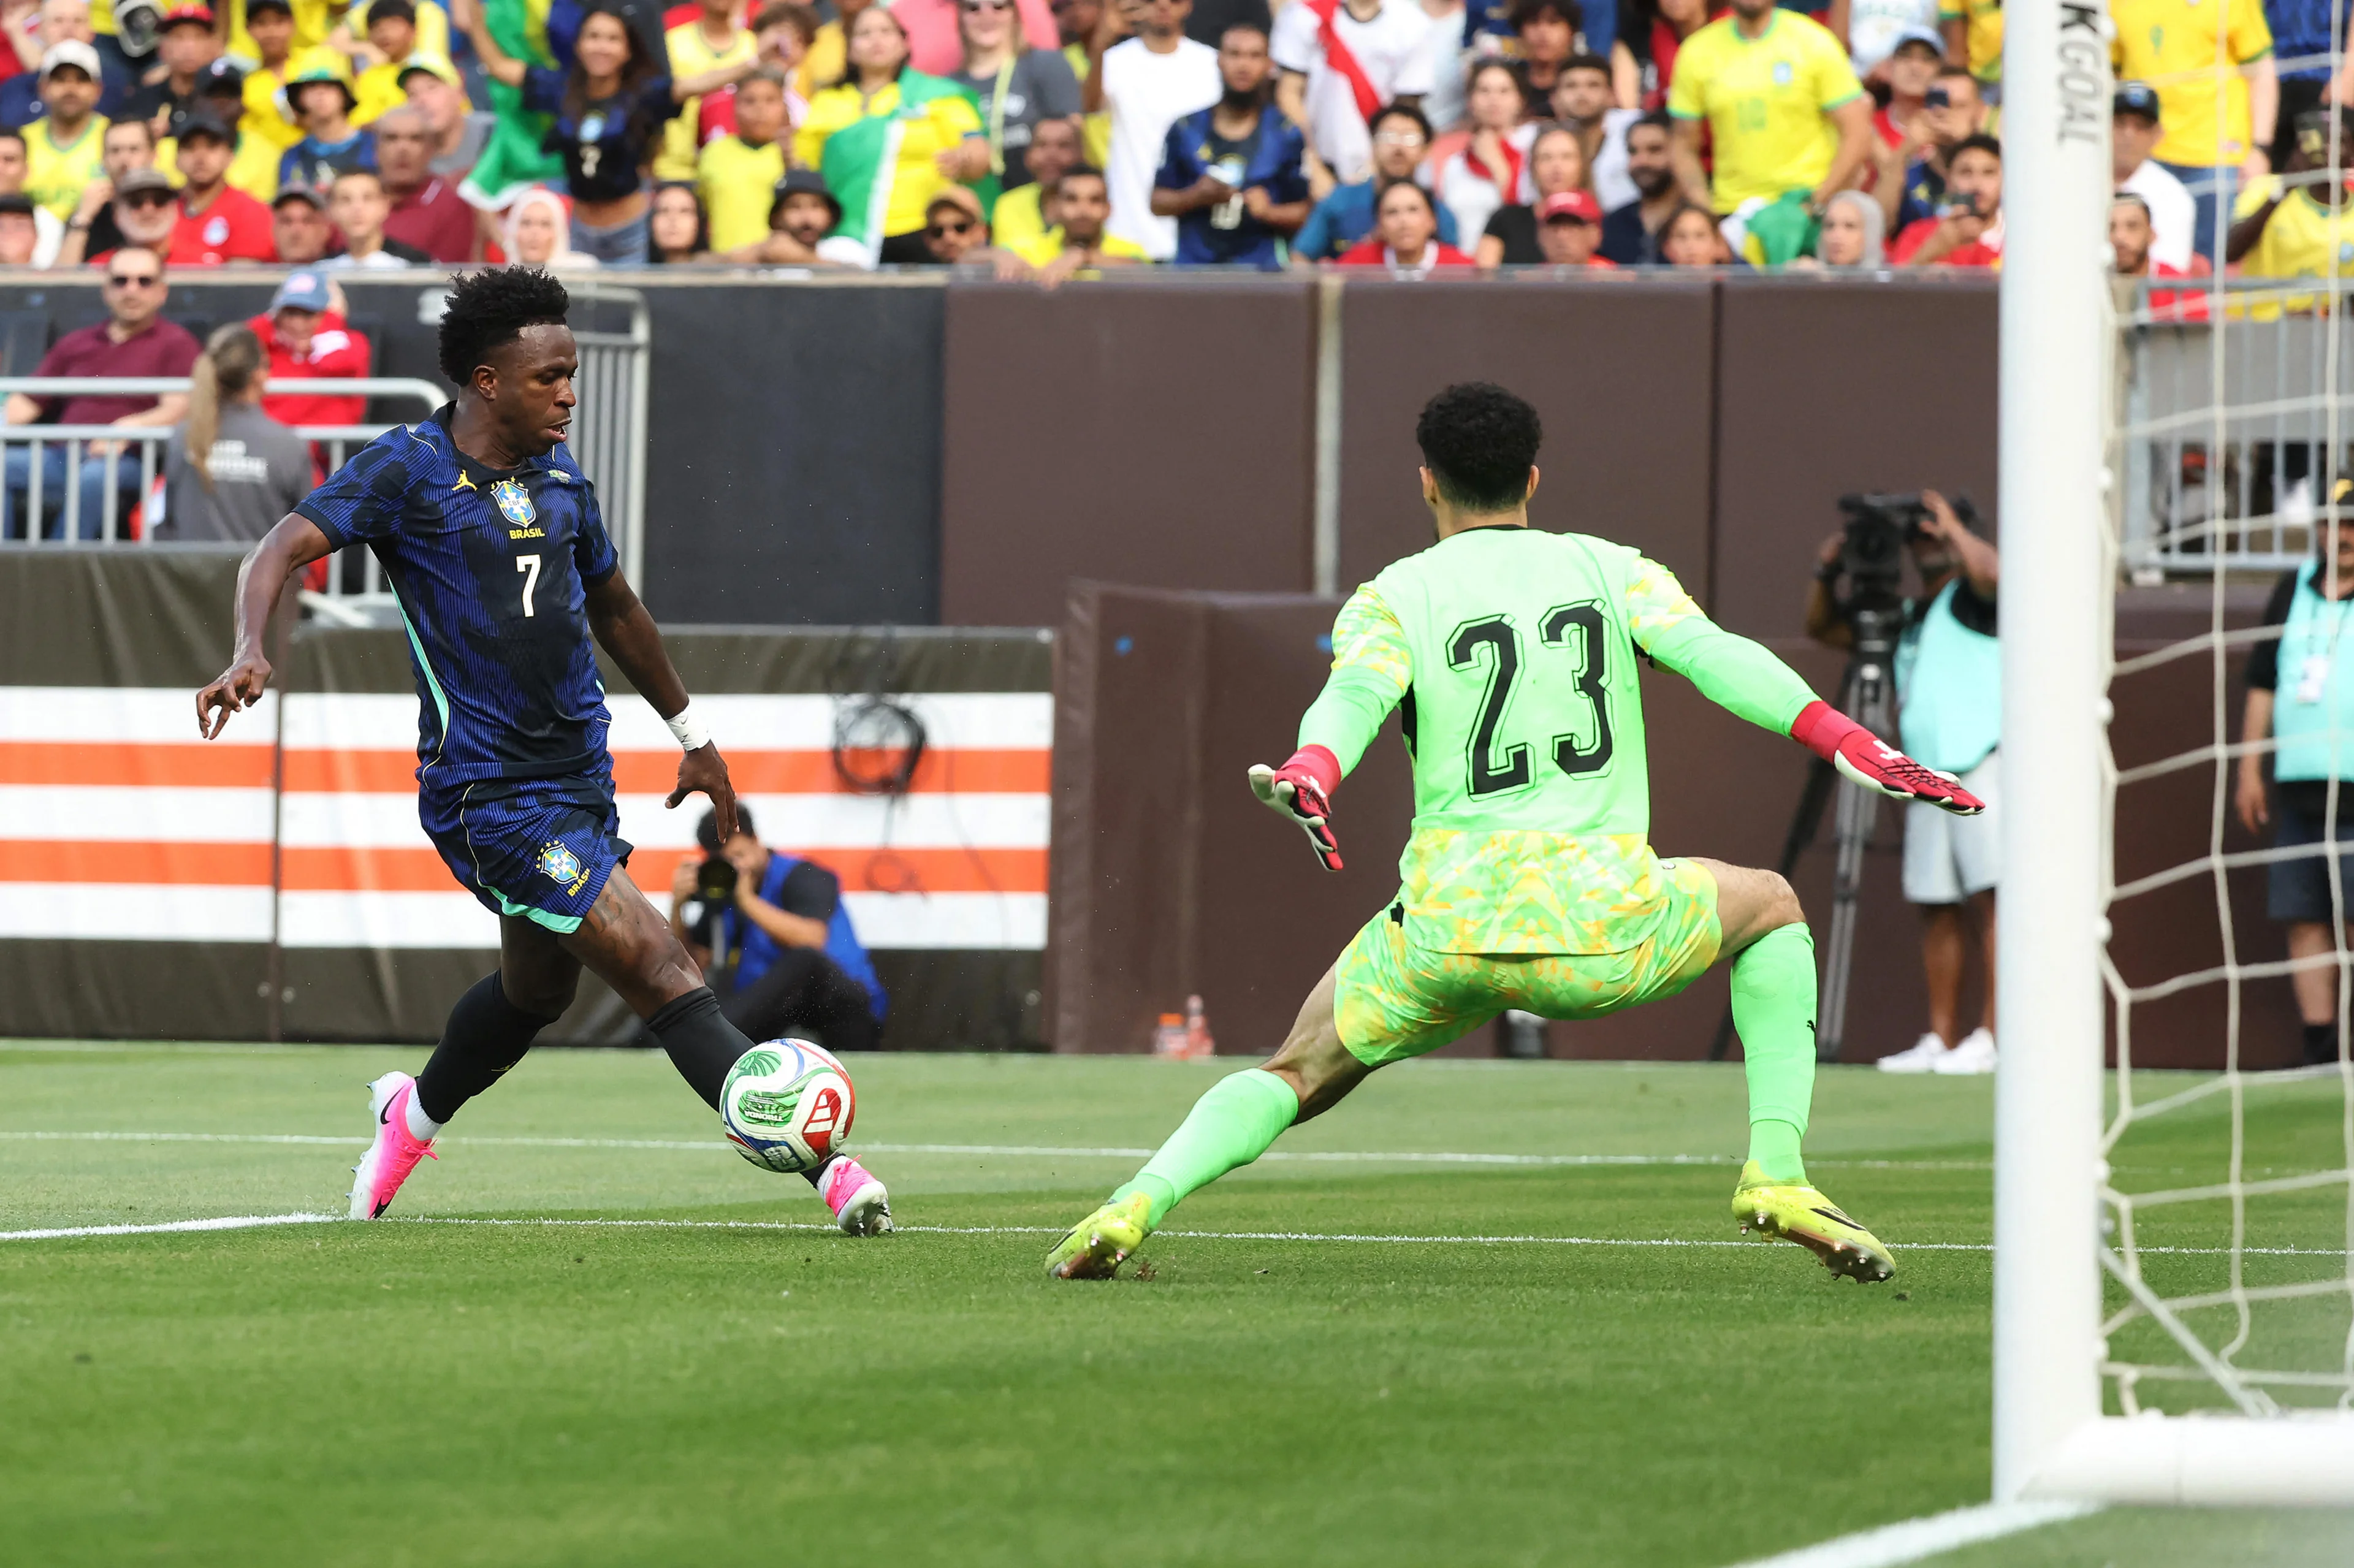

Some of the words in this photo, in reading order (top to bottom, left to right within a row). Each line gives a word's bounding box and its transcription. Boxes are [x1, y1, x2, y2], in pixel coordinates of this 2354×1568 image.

[509, 528, 545, 539] BRASIL
[516, 554, 541, 618] 7
[1446, 598, 1617, 802] 23
[555, 859, 565, 870] CBF
[744, 1109, 784, 1122] TRIONDA
